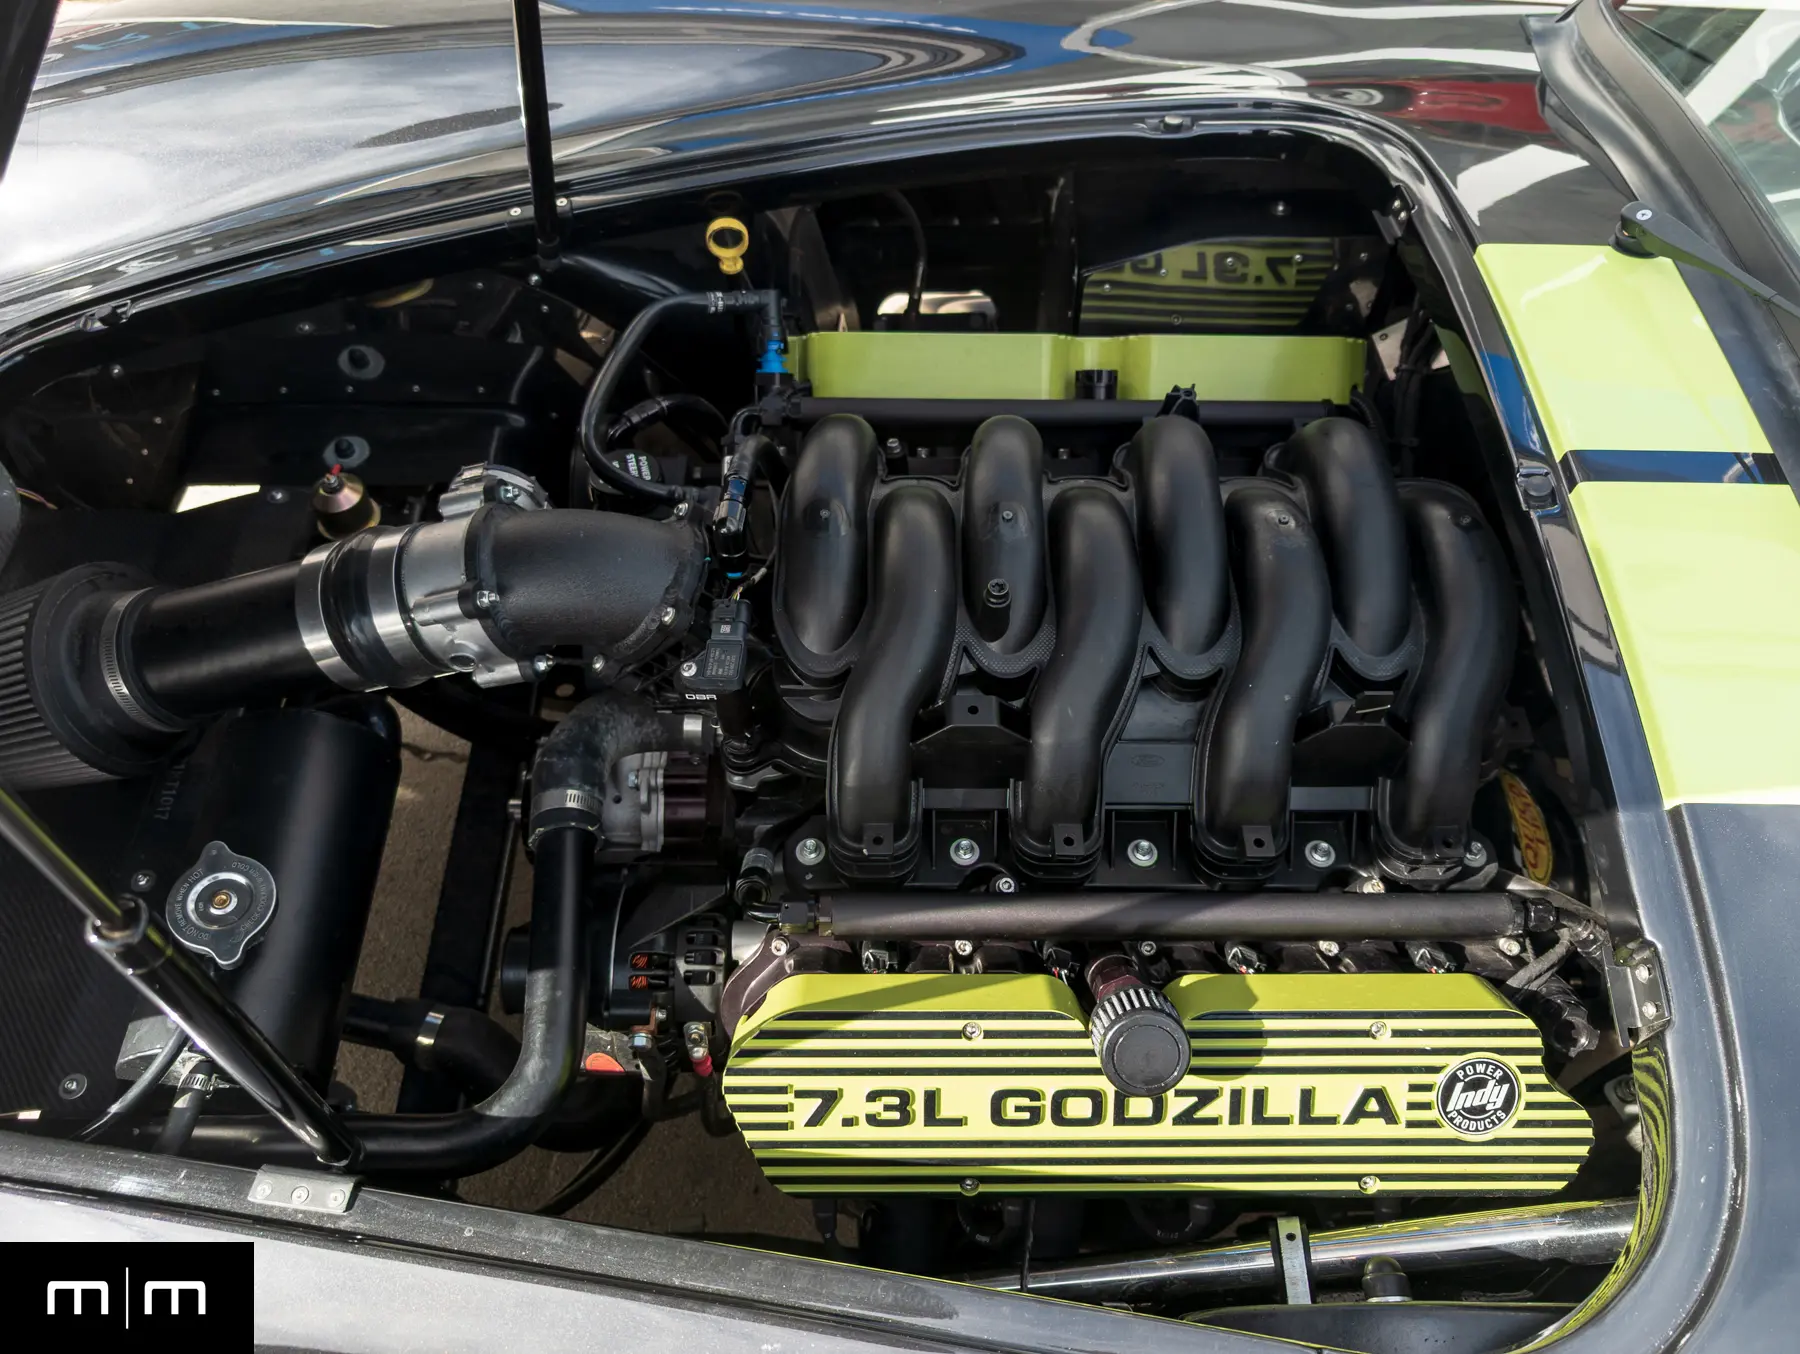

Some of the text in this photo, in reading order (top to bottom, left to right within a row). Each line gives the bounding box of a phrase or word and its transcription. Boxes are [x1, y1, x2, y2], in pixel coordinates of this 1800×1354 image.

[638, 456, 651, 480] POWER
[187, 868, 205, 885] HOT
[176, 883, 190, 902] WHEN
[174, 903, 187, 927] REMOVE
[182, 924, 199, 938] NOT
[1456, 1063, 1504, 1080] POWER
[793, 1086, 1400, 1128] 7.3L GODZILLA
[1445, 1079, 1511, 1112] Indy
[1447, 1109, 1507, 1132] PRODUCTS
